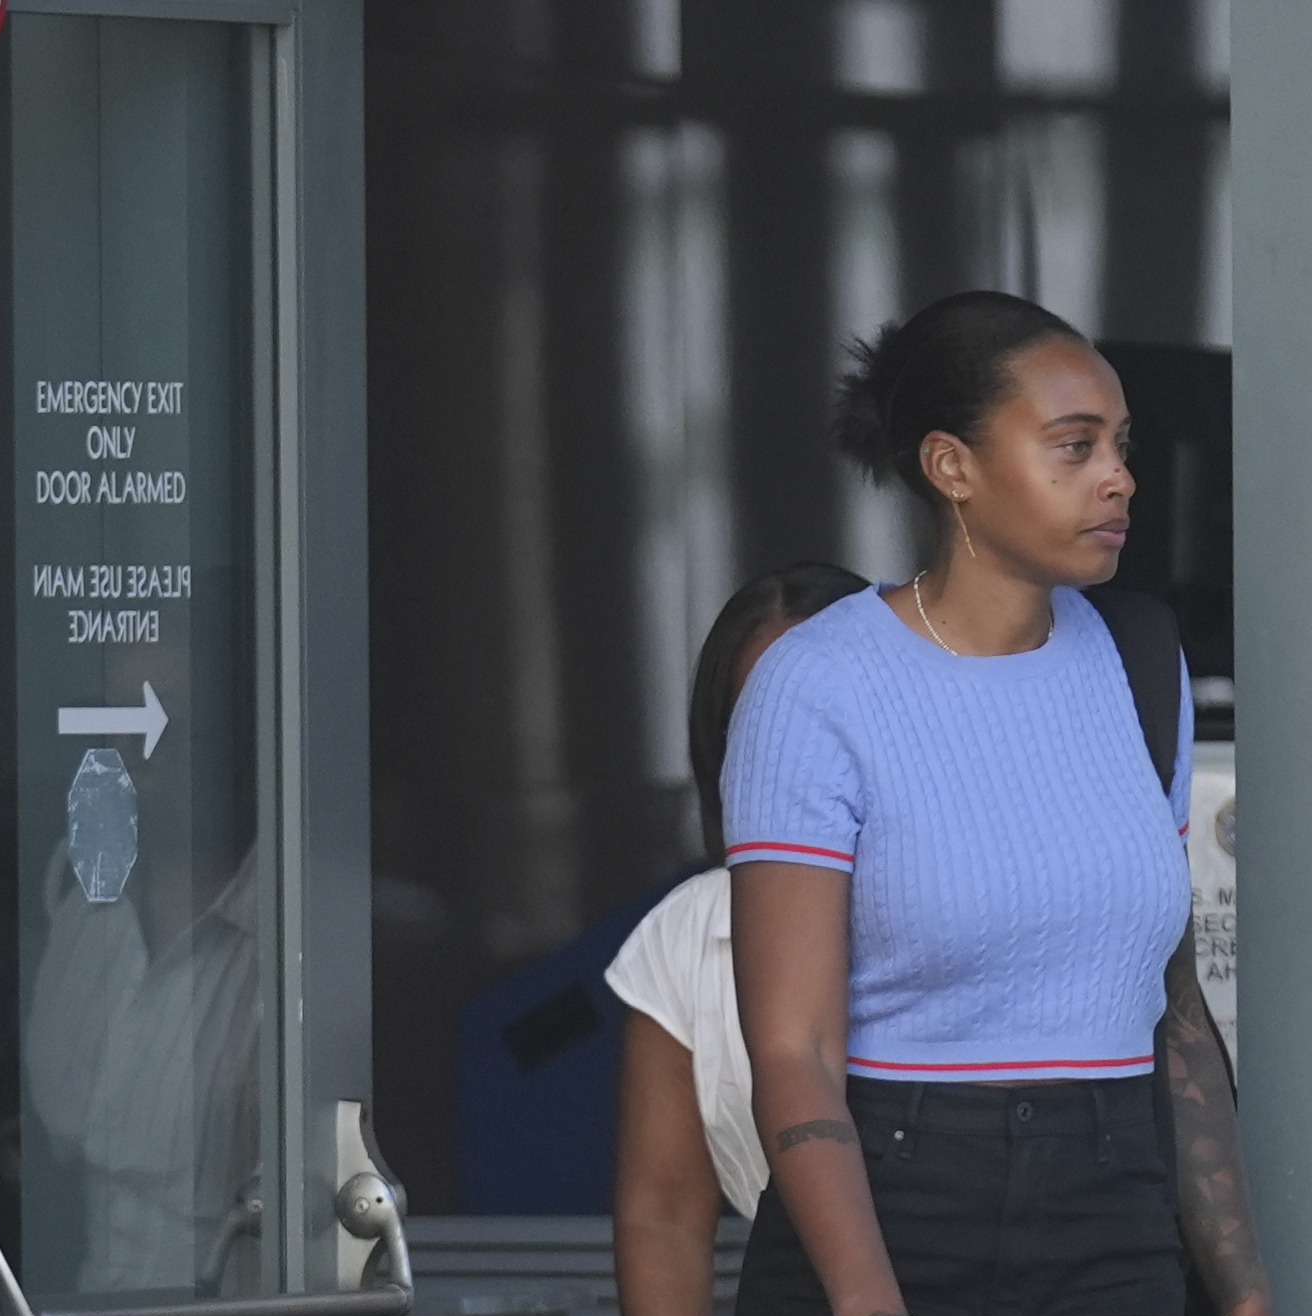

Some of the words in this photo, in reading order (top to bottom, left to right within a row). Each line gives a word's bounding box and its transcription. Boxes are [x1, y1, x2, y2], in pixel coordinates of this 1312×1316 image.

[37, 381, 143, 414] EMERGENCY
[147, 382, 183, 413] EXIT
[87, 426, 135, 459] ONLY
[37, 471, 91, 504] DOOR
[96, 472, 186, 504] ALARMED
